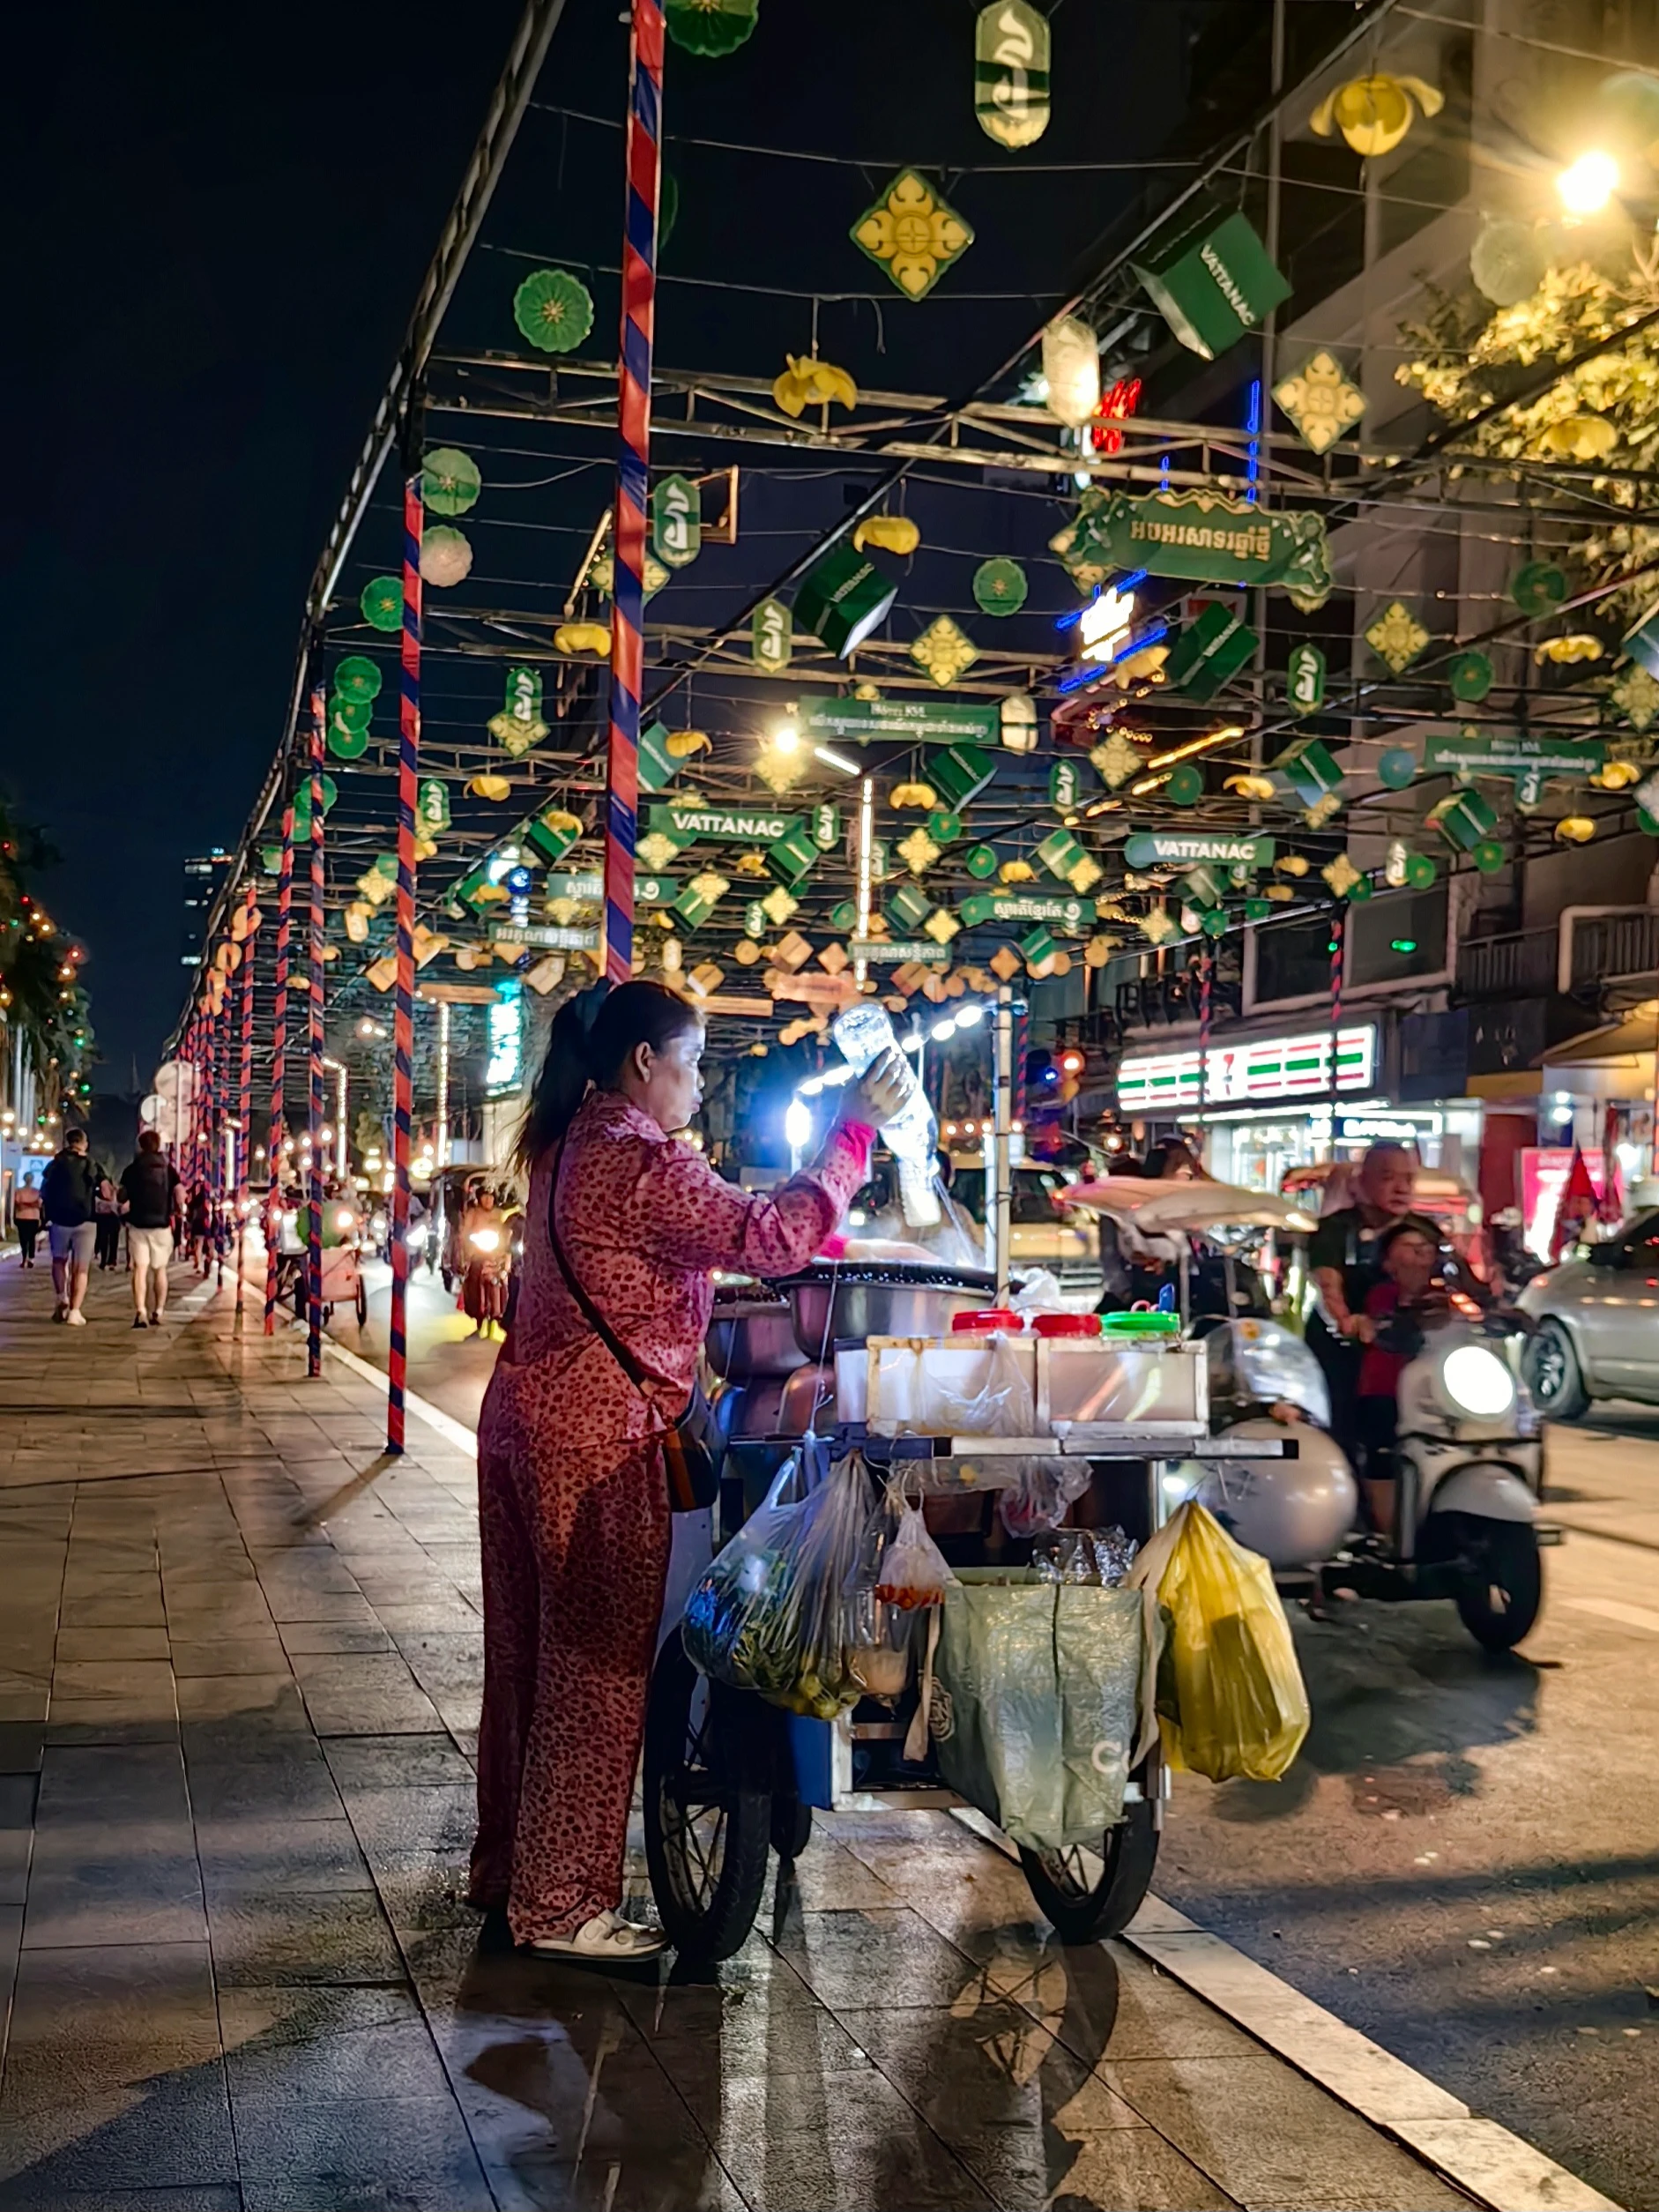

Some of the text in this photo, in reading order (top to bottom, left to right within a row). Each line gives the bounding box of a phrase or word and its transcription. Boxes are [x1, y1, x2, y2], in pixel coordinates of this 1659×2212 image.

[1201, 243, 1255, 326] VATTANAC
[1130, 520, 1270, 561] អបអរសាទរឆ្នាំថ្មី
[672, 813, 785, 838] VATTANAC
[1154, 840, 1255, 861] VATTANAC
